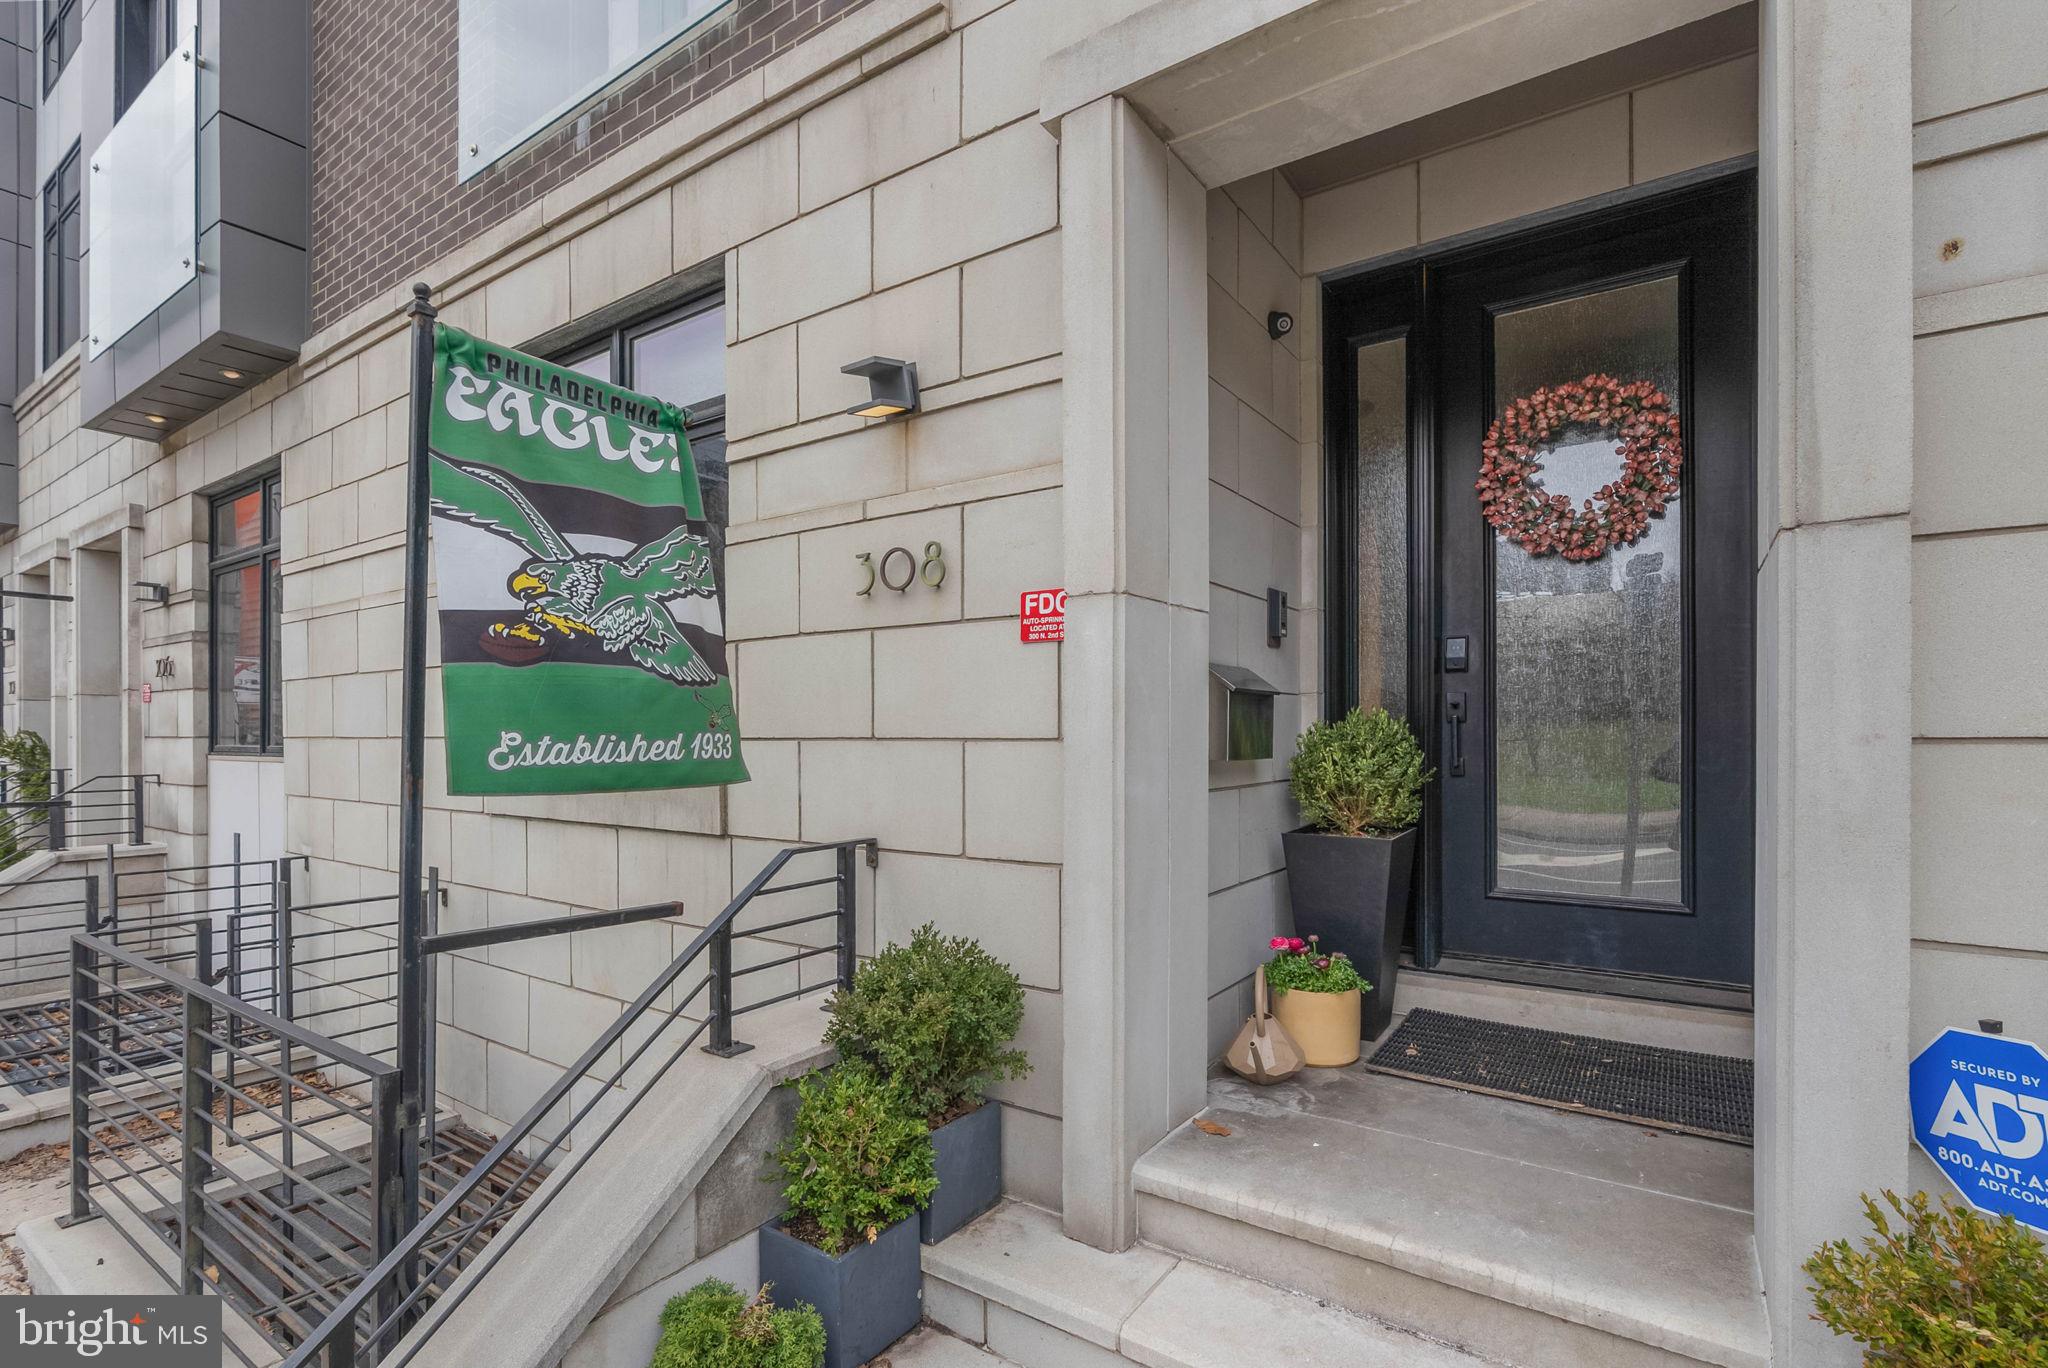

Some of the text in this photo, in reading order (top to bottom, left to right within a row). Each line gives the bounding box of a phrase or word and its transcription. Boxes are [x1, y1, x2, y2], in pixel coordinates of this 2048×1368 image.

[486, 353, 659, 428] PHILADELPHIA
[855, 541, 946, 598] 308
[1029, 624, 1058, 632] LOCATED
[488, 731, 732, 771] Established 1933
[1950, 1059, 2041, 1088] SECURED BY
[1978, 1177, 2048, 1209] ADT.COM
